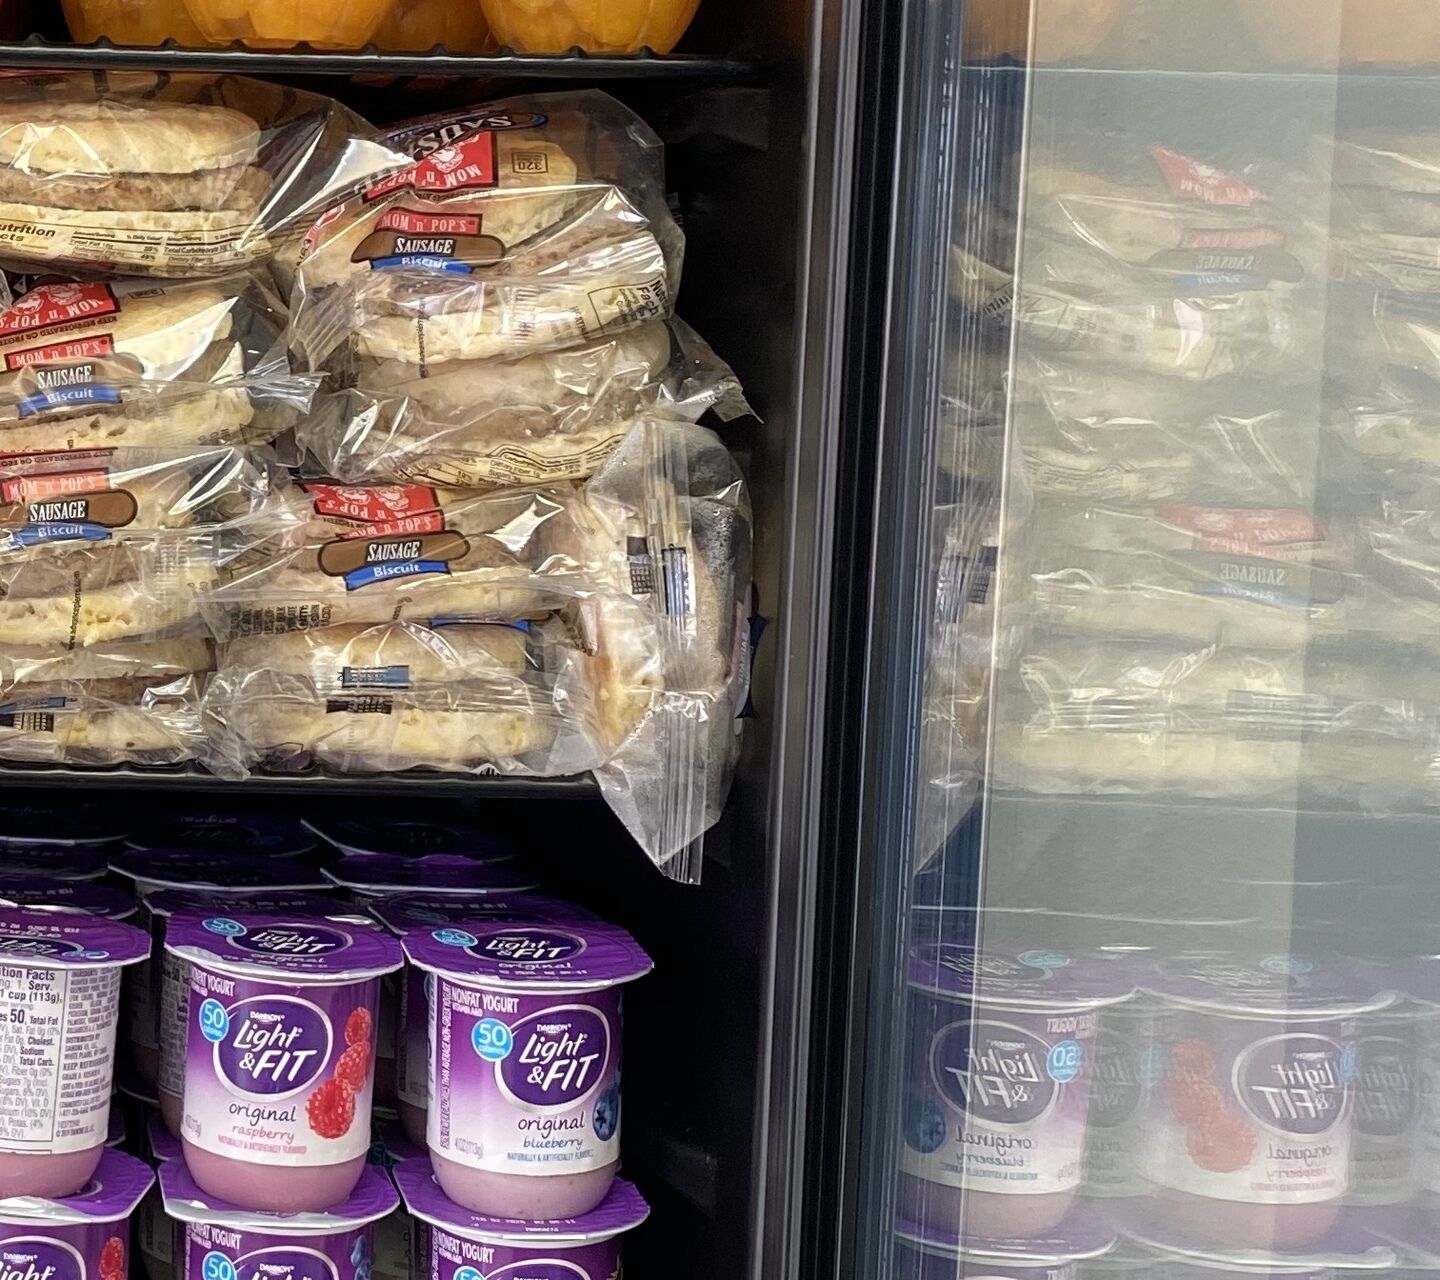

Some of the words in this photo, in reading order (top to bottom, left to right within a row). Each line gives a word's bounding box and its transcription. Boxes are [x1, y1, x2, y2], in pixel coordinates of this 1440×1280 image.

[444, 164, 481, 188] MOM
[383, 214, 409, 229] MOM
[431, 219, 466, 232] POP'S
[395, 238, 453, 253] SAUSAGE
[15, 351, 44, 366] MOM
[66, 341, 100, 356] POP'S
[38, 365, 92, 389] SAUSAGE
[47, 388, 94, 404] Biscuit
[8, 480, 38, 500] MOM
[62, 475, 96, 493] POP'S
[30, 500, 86, 521] SAUSAGE
[326, 500, 369, 518] POP'S
[37, 522, 84, 538] Biscuit
[397, 516, 431, 532] POP'S
[367, 542, 420, 561] SAUSAGE
[373, 564, 420, 577] Biscuit
[26, 969, 55, 980] Facts
[29, 980, 53, 991] Serv.
[8, 991, 26, 1002] cup
[452, 987, 481, 1007] NONFAT
[482, 994, 519, 1013] YOGURT
[30, 1015, 46, 1025] Total
[48, 1016, 59, 1025] Fat
[203, 1006, 225, 1029] 50
[233, 1020, 300, 1049] Light
[477, 1026, 508, 1047] 50
[518, 1033, 586, 1064] Light
[229, 1102, 297, 1129] original
[518, 1112, 586, 1138] original
[232, 1125, 295, 1142] raspberry
[523, 1136, 583, 1150] blueberry
[207, 1261, 232, 1280] 50
